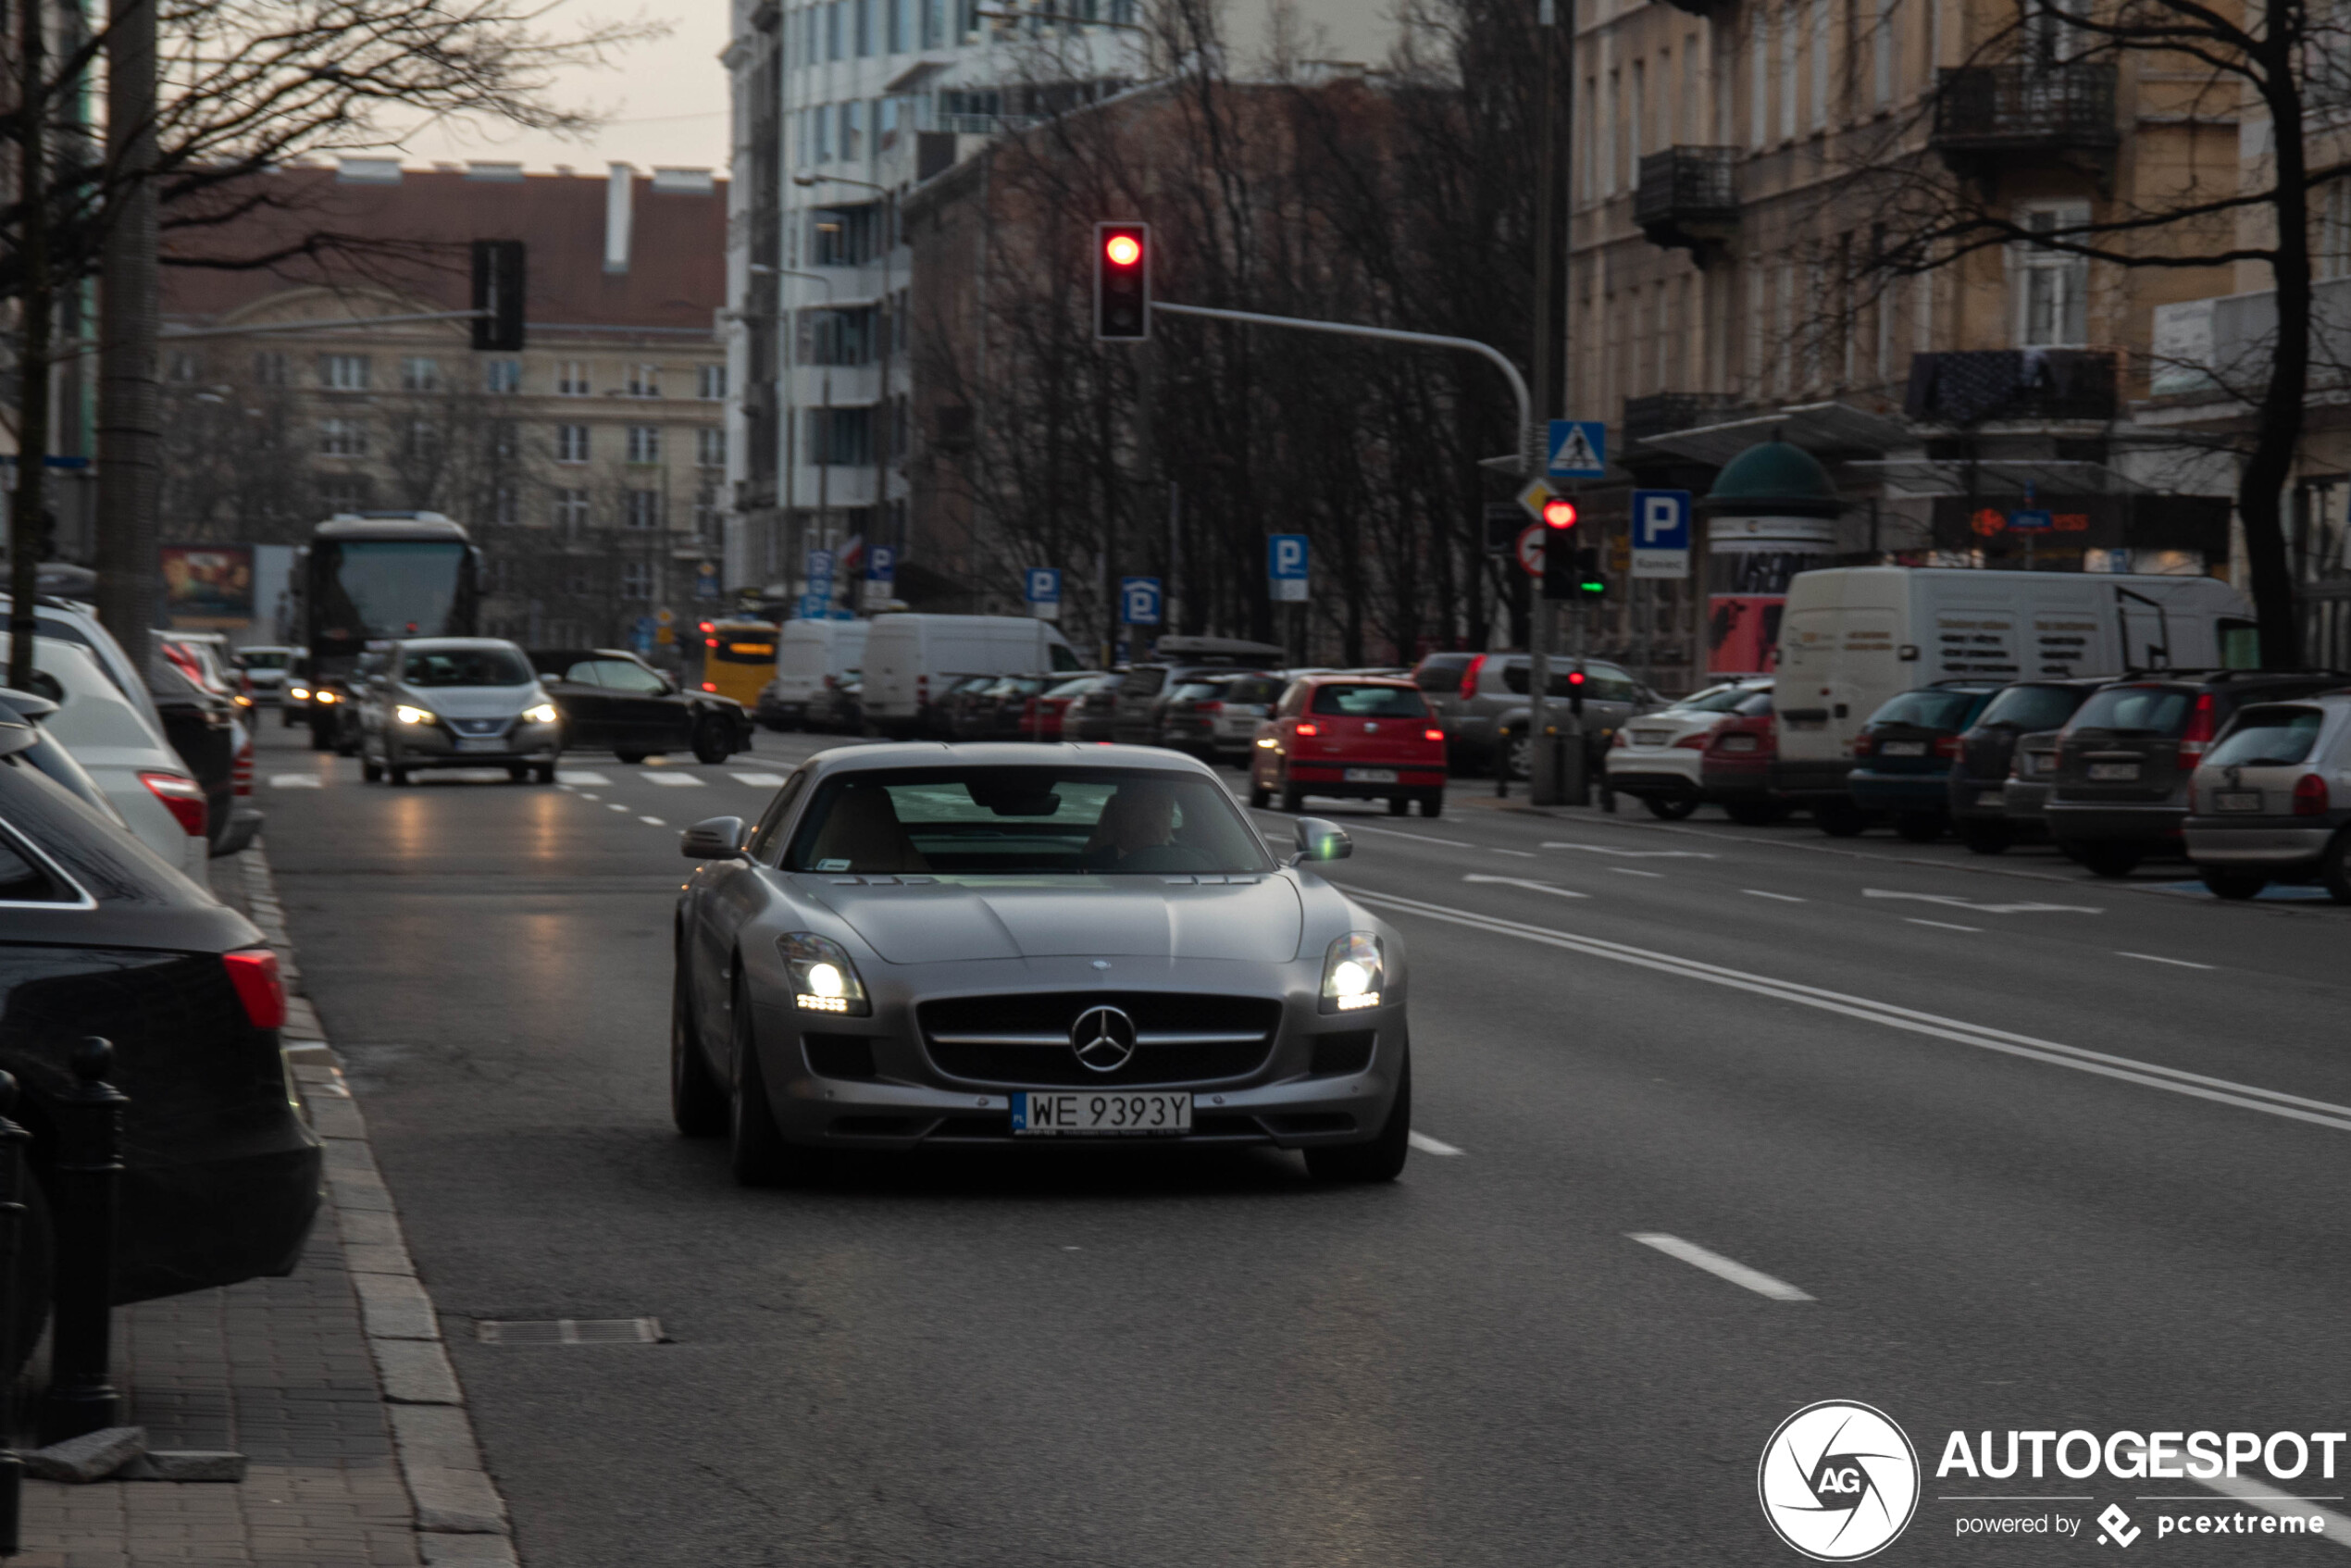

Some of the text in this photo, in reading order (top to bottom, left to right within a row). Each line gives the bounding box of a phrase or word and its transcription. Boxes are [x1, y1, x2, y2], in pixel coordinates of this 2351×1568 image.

[1644, 496, 1680, 542] P
[1276, 540, 1301, 575] P
[1032, 571, 1054, 599] P
[1014, 1114, 1025, 1123] PL
[1032, 1096, 1187, 1126] WE 9393Y
